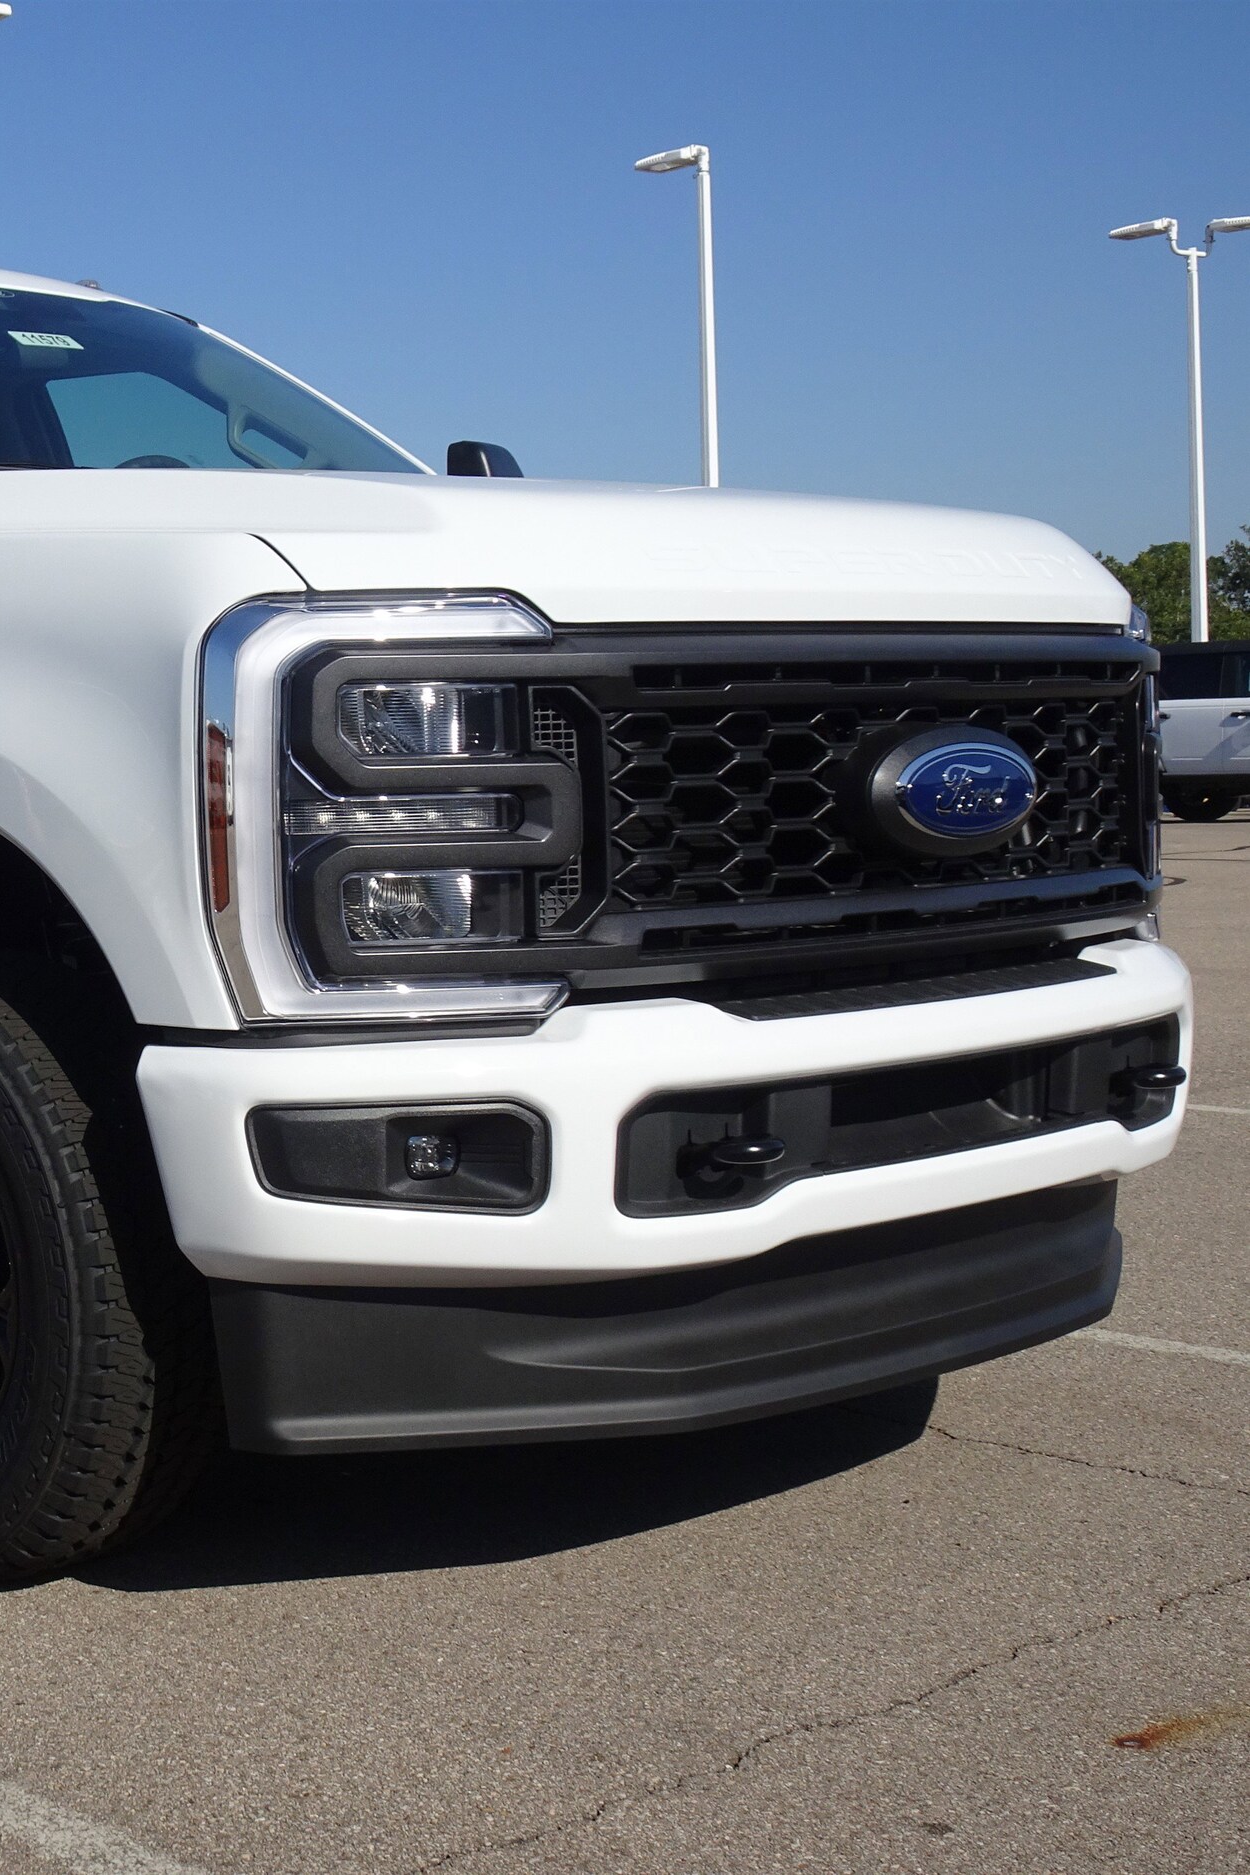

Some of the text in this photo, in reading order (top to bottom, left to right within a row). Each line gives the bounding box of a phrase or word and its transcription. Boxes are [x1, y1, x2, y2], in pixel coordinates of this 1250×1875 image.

[22, 333, 70, 346] 11579
[643, 543, 931, 577] SUPER
[936, 763, 1010, 816] Ford
